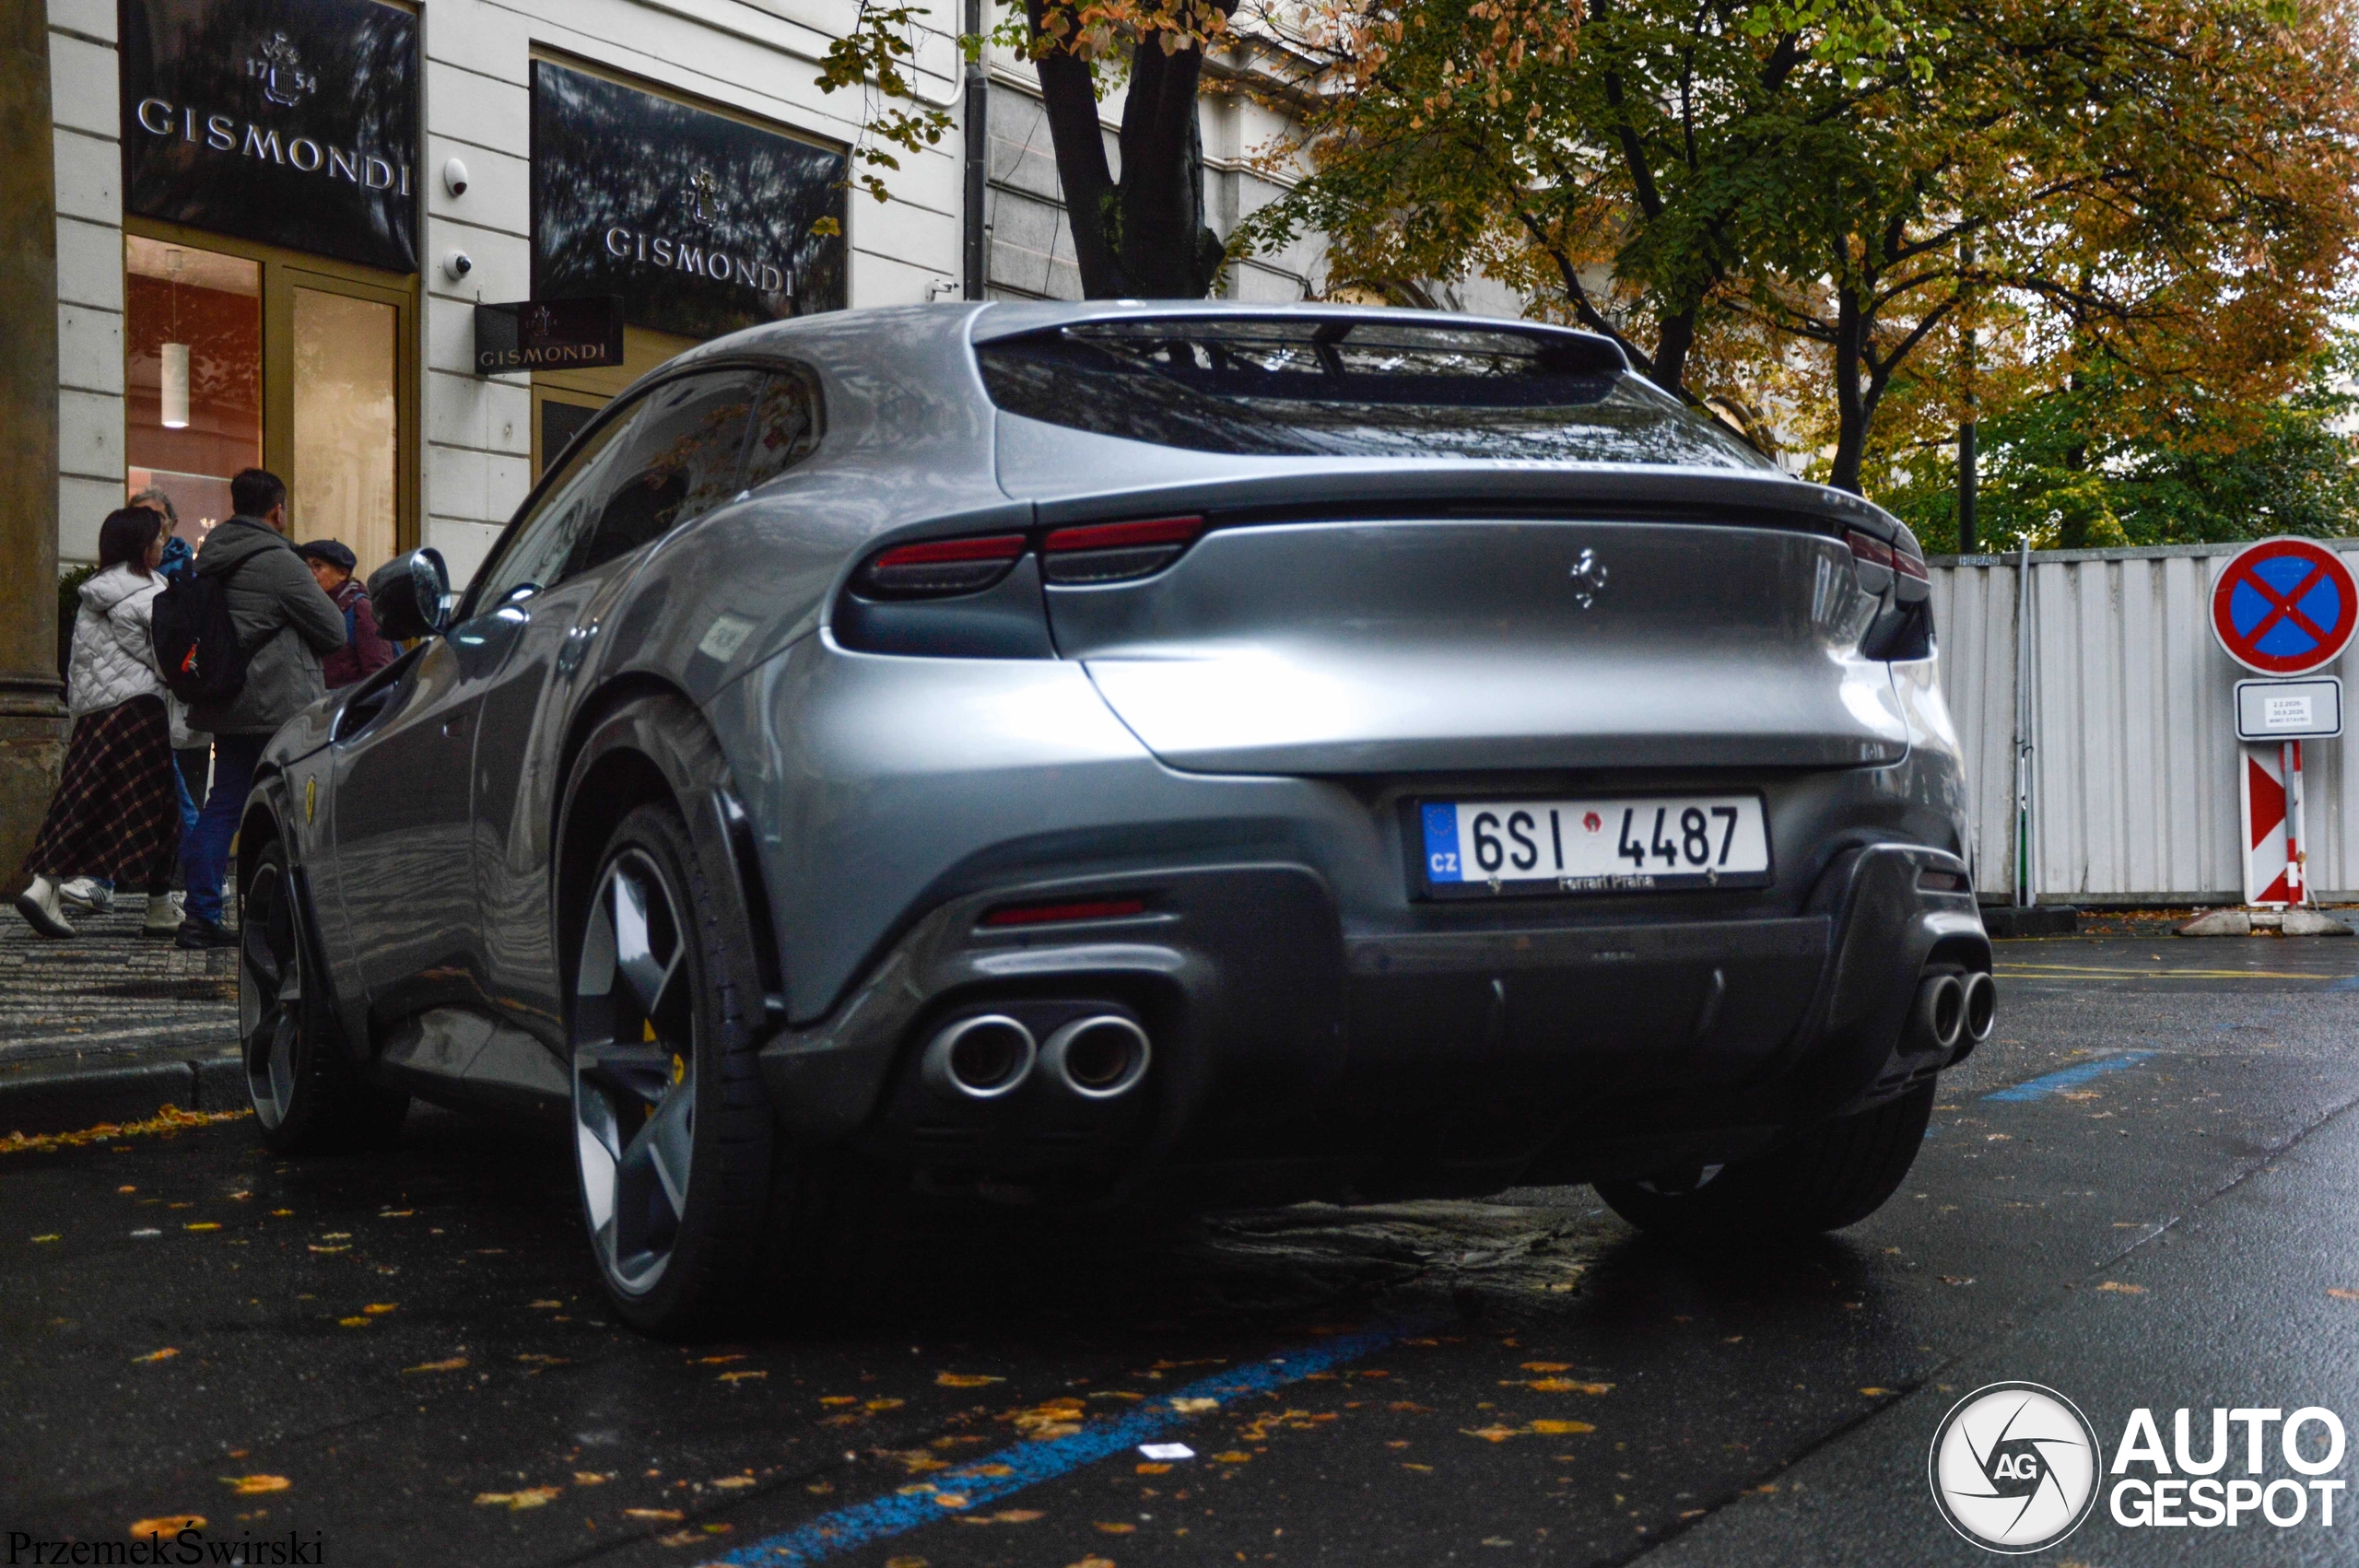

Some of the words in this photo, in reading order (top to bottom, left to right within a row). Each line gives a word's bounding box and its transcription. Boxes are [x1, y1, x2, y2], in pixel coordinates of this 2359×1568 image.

[246, 57, 269, 79] 17
[295, 72, 317, 93] 54
[138, 98, 411, 196] GISMONDI
[606, 227, 794, 297] GISMONDI
[480, 343, 604, 367] GISMONDI
[1960, 555, 1999, 566] HERAS
[1618, 806, 1738, 868] 4487
[1430, 852, 1458, 872] CZ
[1557, 875, 1609, 891] Ferrari
[1611, 873, 1656, 890] Praha
